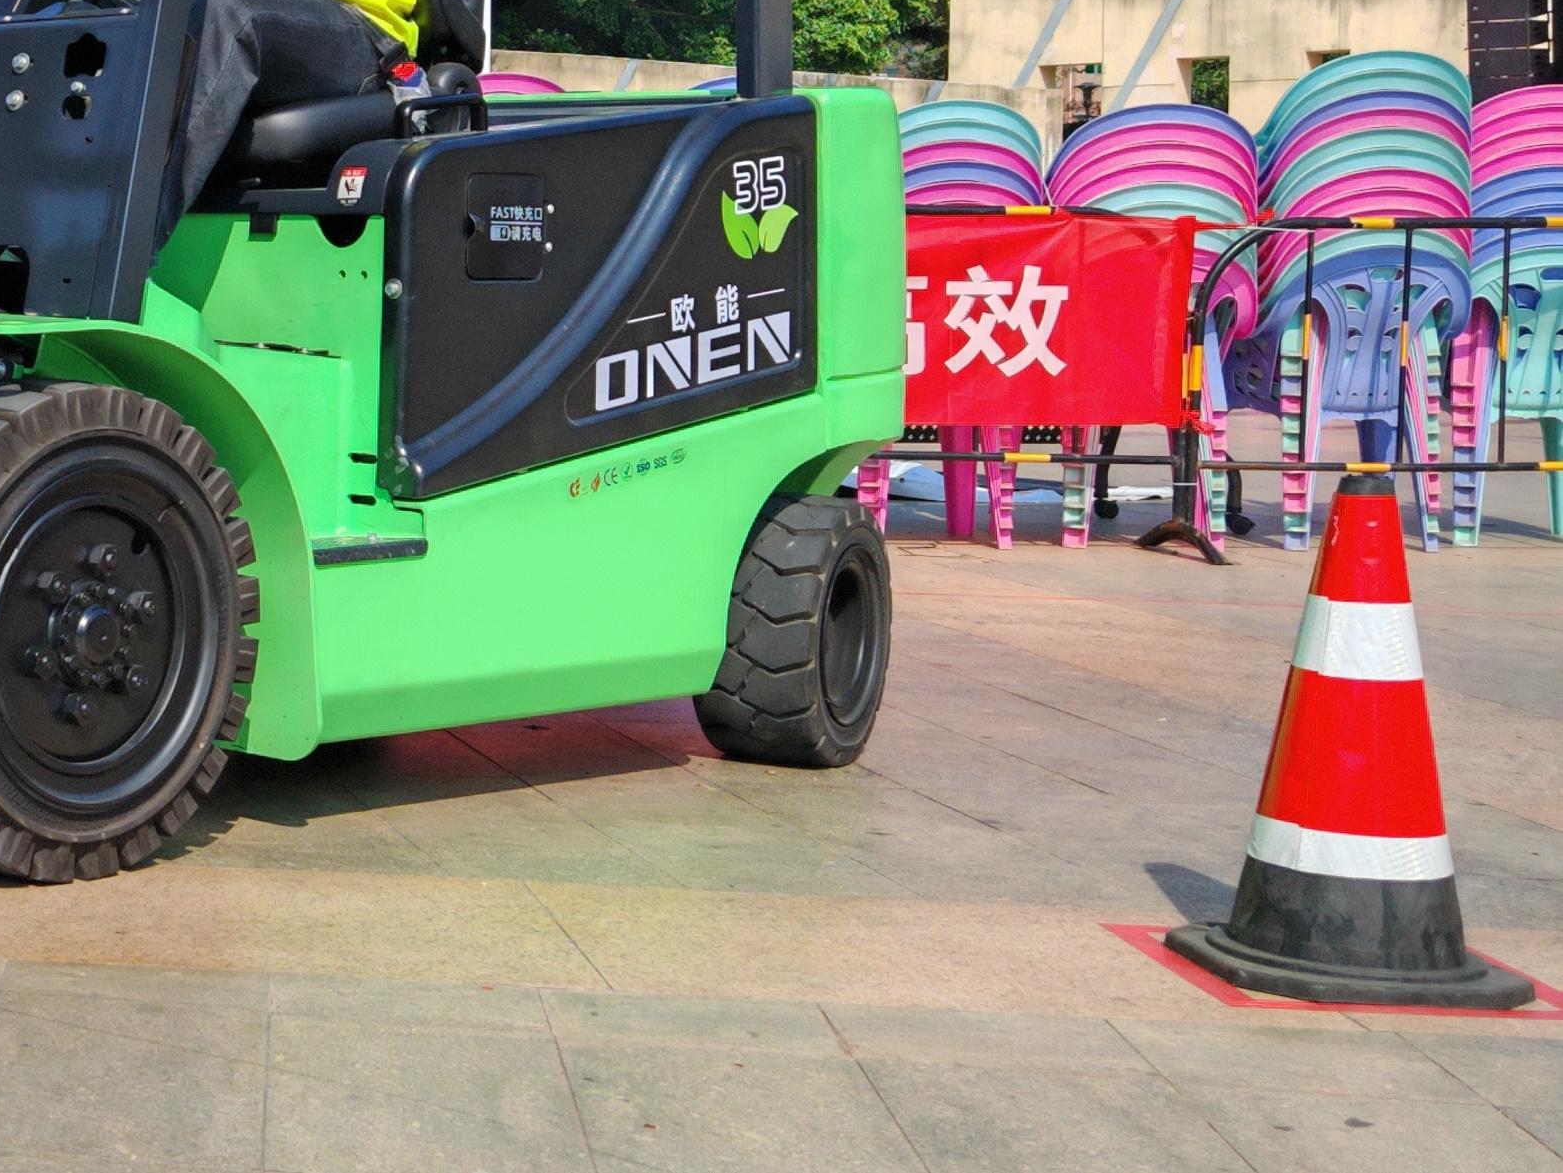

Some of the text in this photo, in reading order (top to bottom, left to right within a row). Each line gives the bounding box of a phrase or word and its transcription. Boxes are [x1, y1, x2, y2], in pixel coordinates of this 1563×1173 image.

[733, 156, 786, 215] 35
[595, 311, 791, 412] ONEN
[902, 265, 1069, 377] 效
